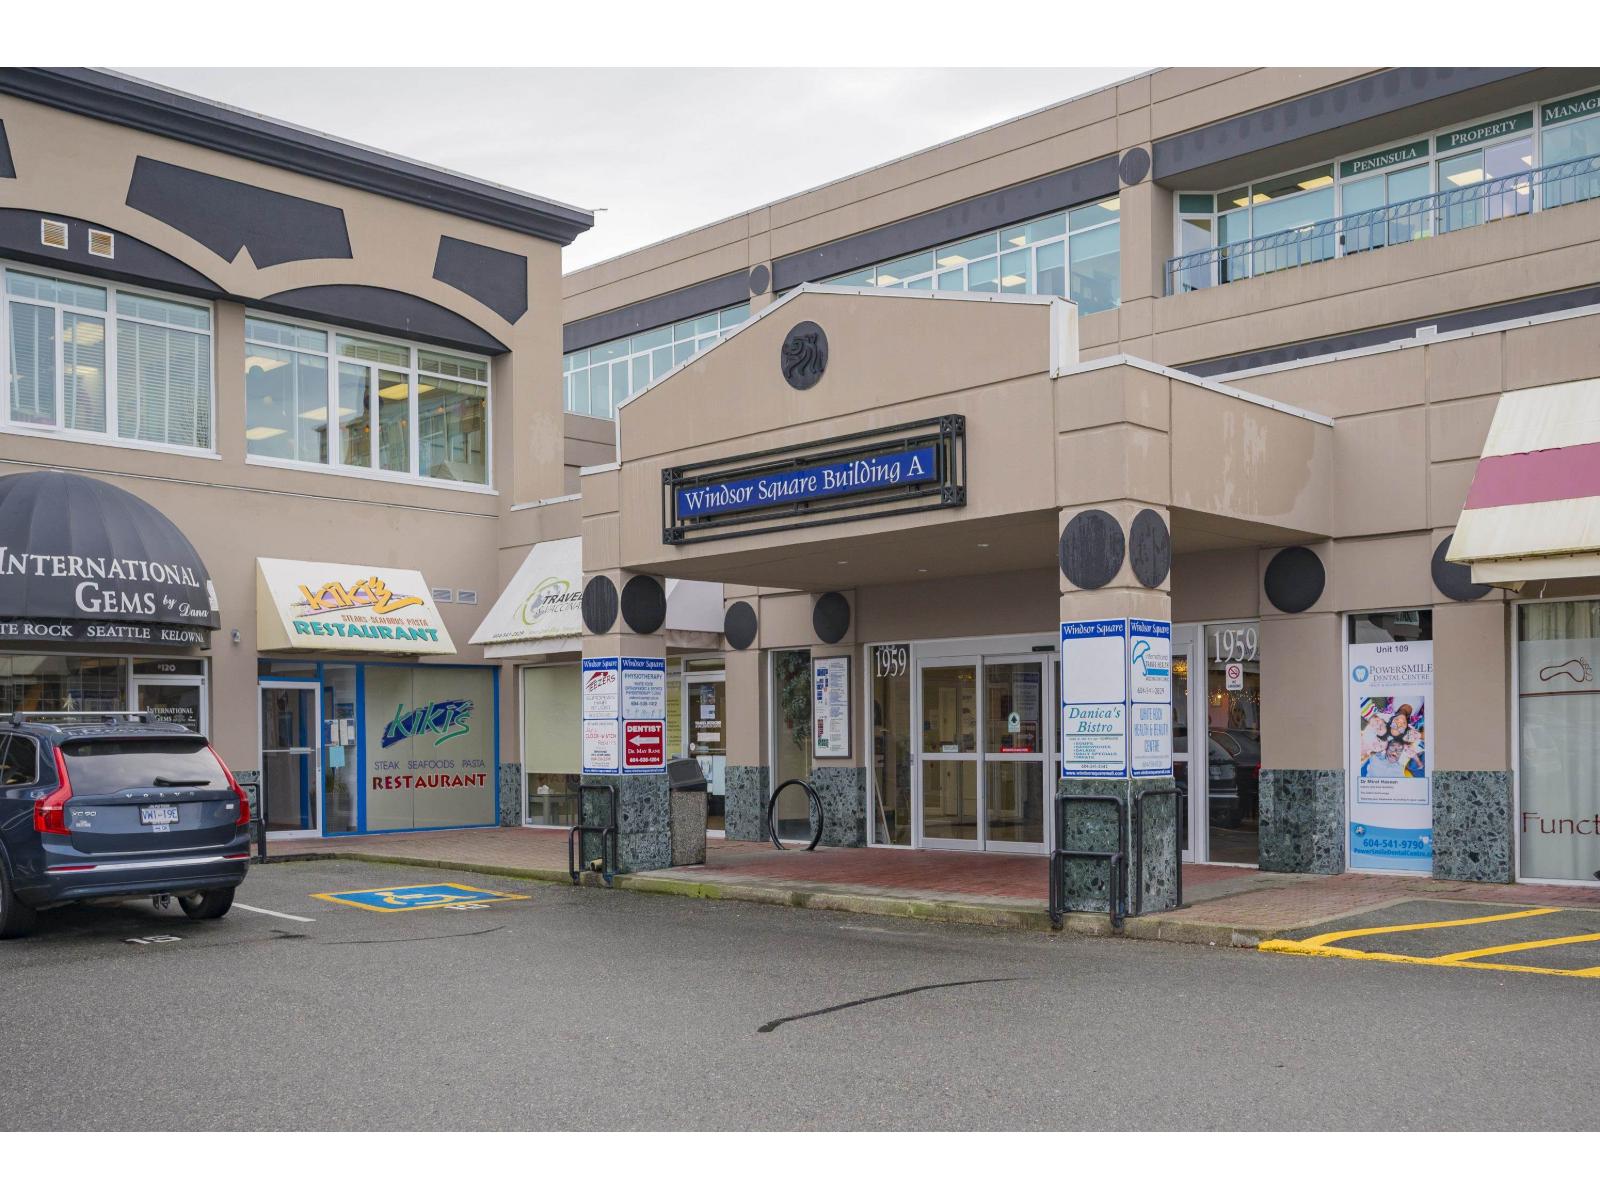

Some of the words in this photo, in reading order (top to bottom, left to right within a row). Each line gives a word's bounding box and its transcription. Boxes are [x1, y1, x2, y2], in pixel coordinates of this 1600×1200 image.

[1353, 148, 1417, 173] PENINSULA
[1451, 119, 1517, 146] PROPERTY
[685, 484, 754, 511] Windsor
[758, 475, 818, 501] Square
[822, 458, 901, 491] Building
[906, 455, 925, 477] A
[0, 546, 200, 588] INTERNATIONAL
[75, 581, 156, 615] GEMS
[163, 594, 177, 610] by
[179, 602, 209, 618] Dana
[23, 624, 74, 637] ROCK
[86, 625, 150, 638] SEATTLE
[161, 629, 205, 643] KELOWNA
[292, 620, 439, 642] RESTAURANT
[1063, 623, 1095, 635] Windsor
[1096, 623, 1124, 636] Square
[1131, 621, 1152, 633] Windsor
[1152, 624, 1170, 636] Square
[1213, 627, 1257, 664] 1959
[1376, 646, 1393, 654] Unit
[1395, 644, 1409, 653] 109
[584, 659, 601, 668] Windsor
[602, 659, 618, 669] Square
[622, 659, 645, 667] Windsor
[645, 660, 665, 670] Square
[876, 647, 907, 678] 1959
[1401, 673, 1430, 681] CENTRE
[146, 705, 194, 714] INTERNATIONAL
[1069, 707, 1121, 719] Danica's
[626, 725, 662, 733] DENTIST
[1077, 721, 1113, 732] Bistro
[374, 761, 400, 770] STEAK
[407, 760, 455, 769] SEAFOODS
[462, 759, 486, 768] PASTA
[372, 774, 487, 790] RESTAURANT
